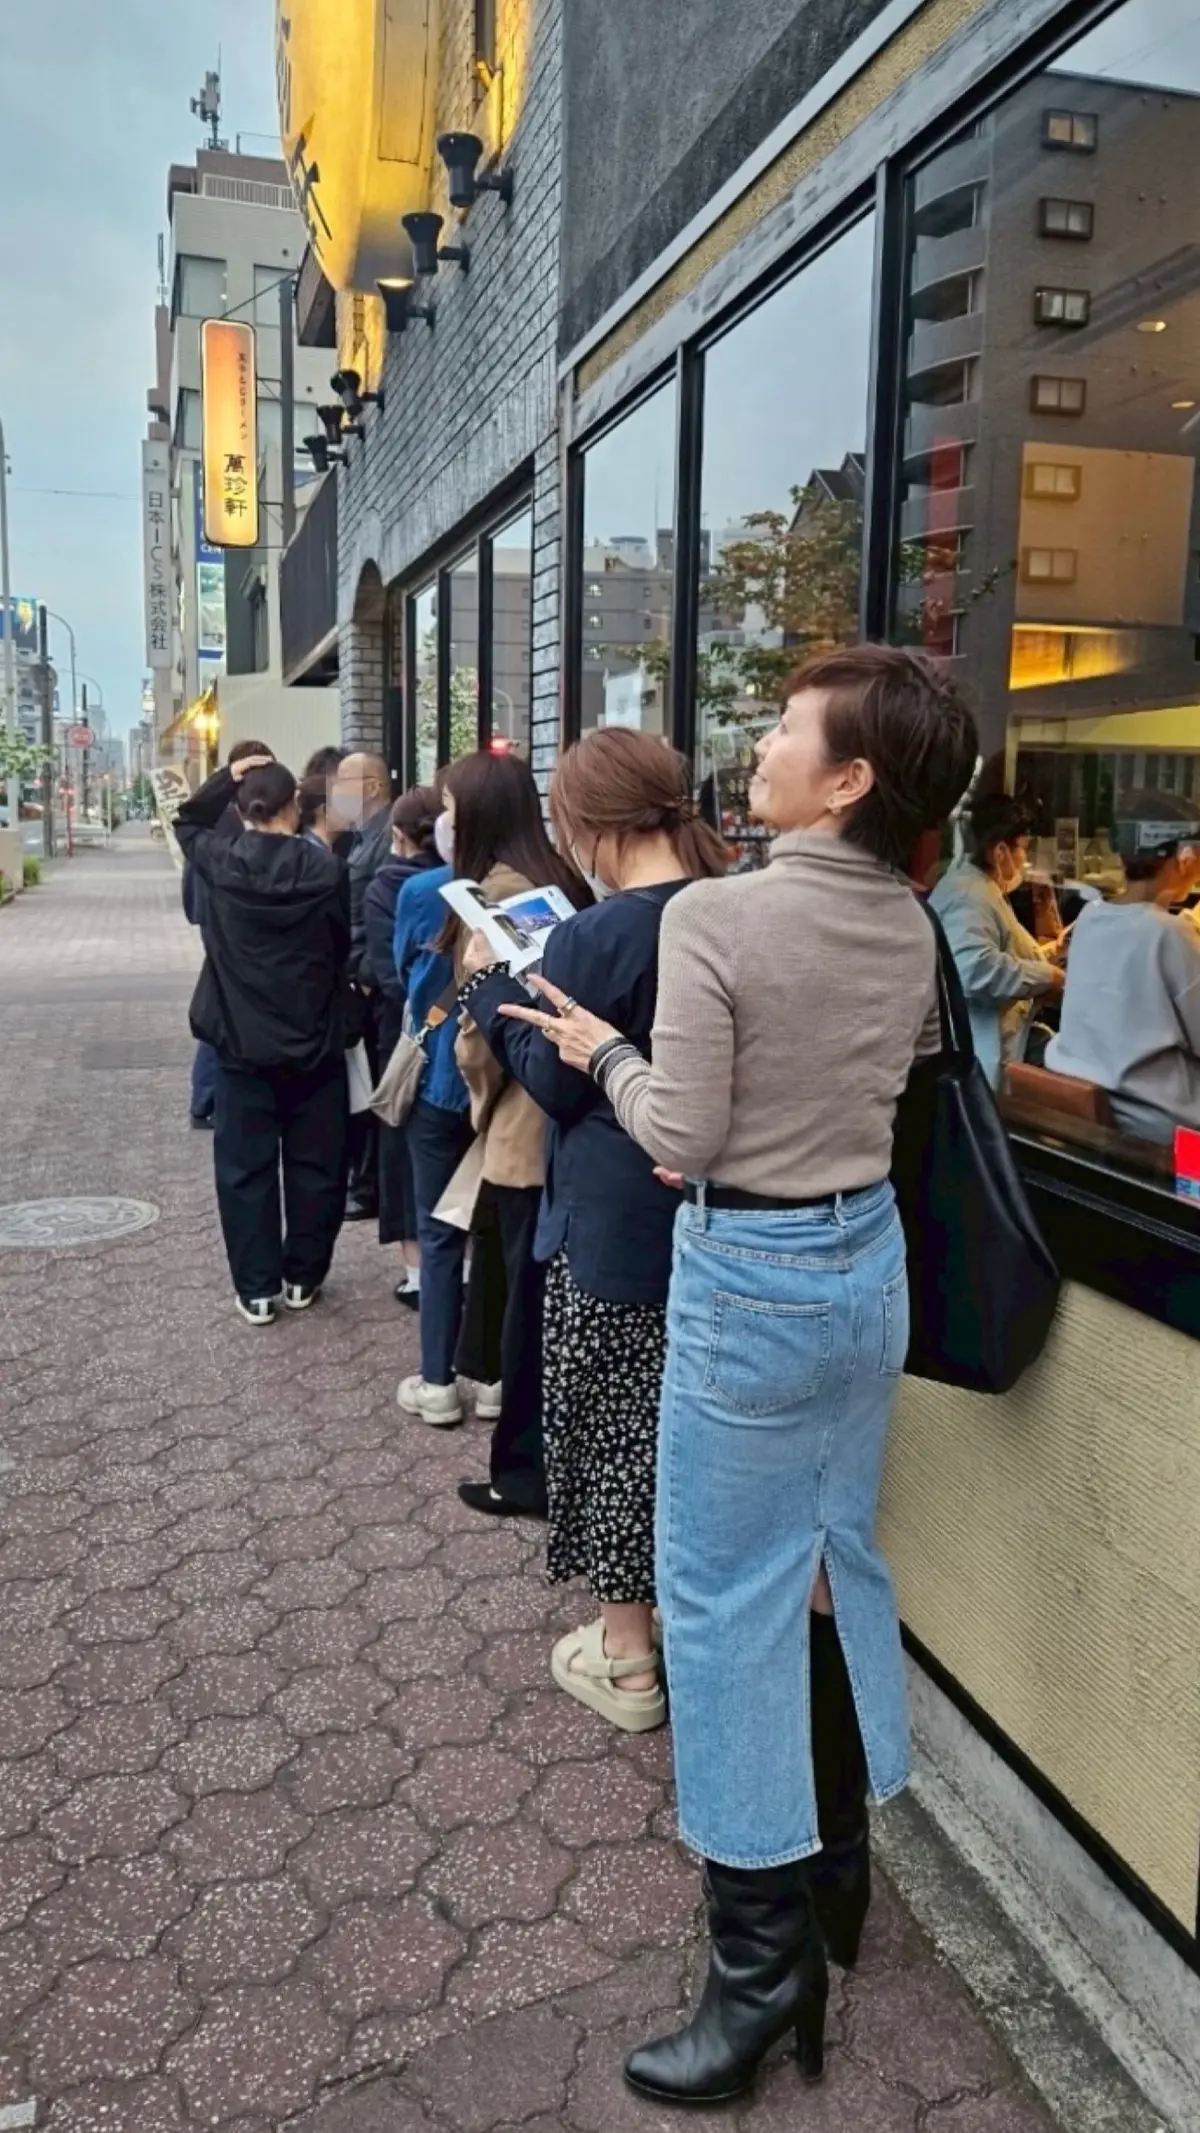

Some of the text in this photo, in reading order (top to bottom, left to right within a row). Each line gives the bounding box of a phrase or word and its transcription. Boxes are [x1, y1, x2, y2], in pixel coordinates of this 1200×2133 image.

[223, 453, 248, 518] 萬珍軒
[148, 491, 167, 650] 日本ICS株式会社
